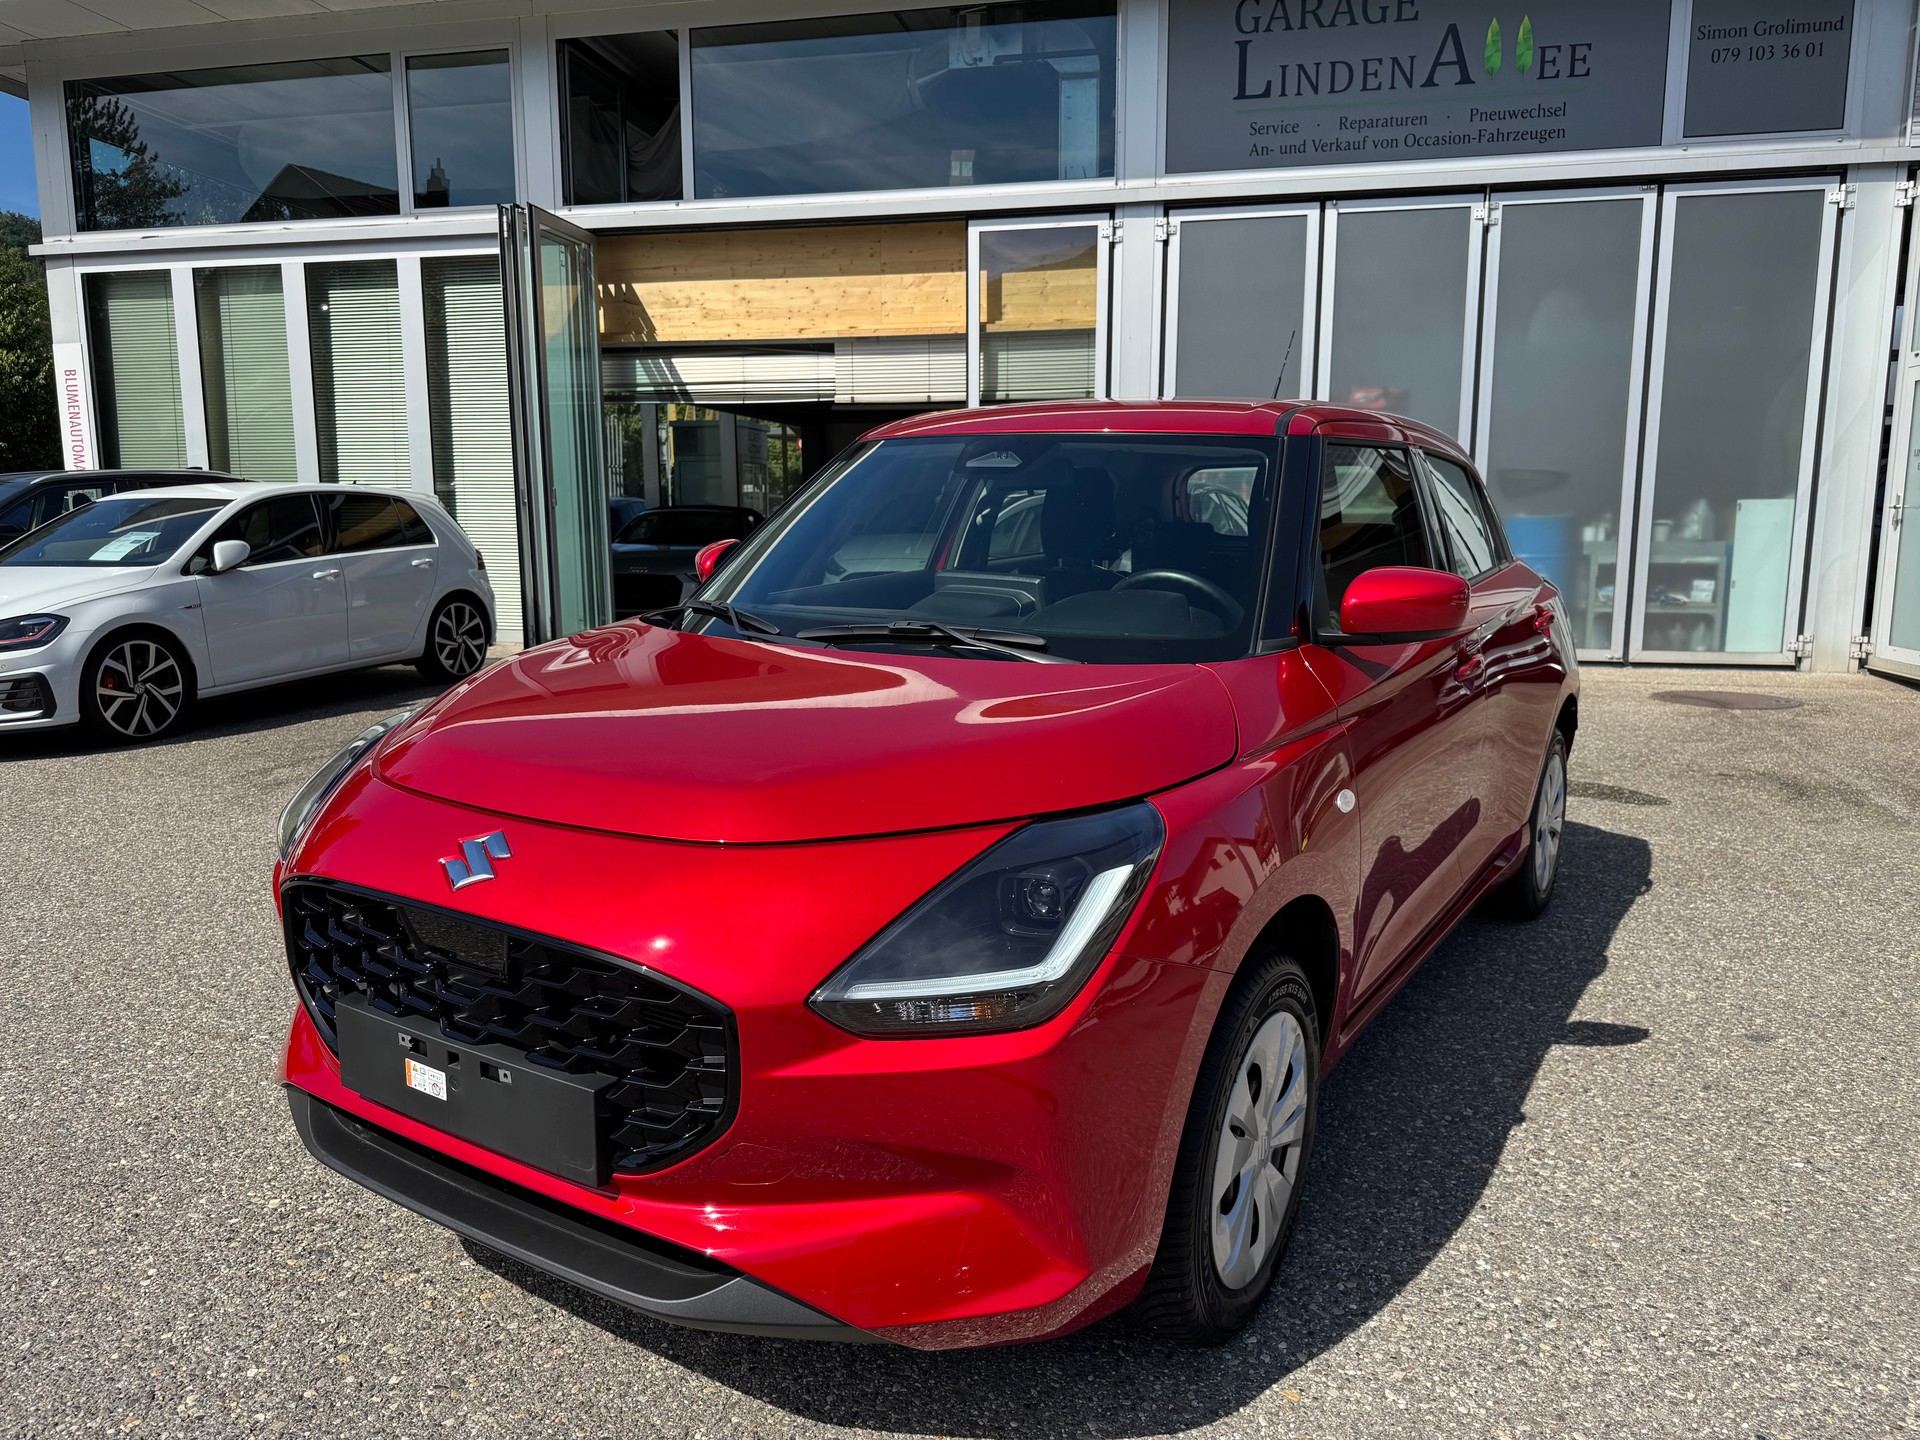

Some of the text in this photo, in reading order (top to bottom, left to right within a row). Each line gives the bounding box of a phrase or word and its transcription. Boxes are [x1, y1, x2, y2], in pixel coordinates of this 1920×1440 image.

[1234, 0, 1419, 35] GARAGE
[1697, 15, 1845, 41] Simon Grolimund
[1710, 41, 1824, 64] 079 103 36 01
[1249, 101, 1567, 136] Service Reparaturen Pneuwechsel
[1248, 126, 1567, 157] An- und Verkauf von Occasion-Fahrzeugen
